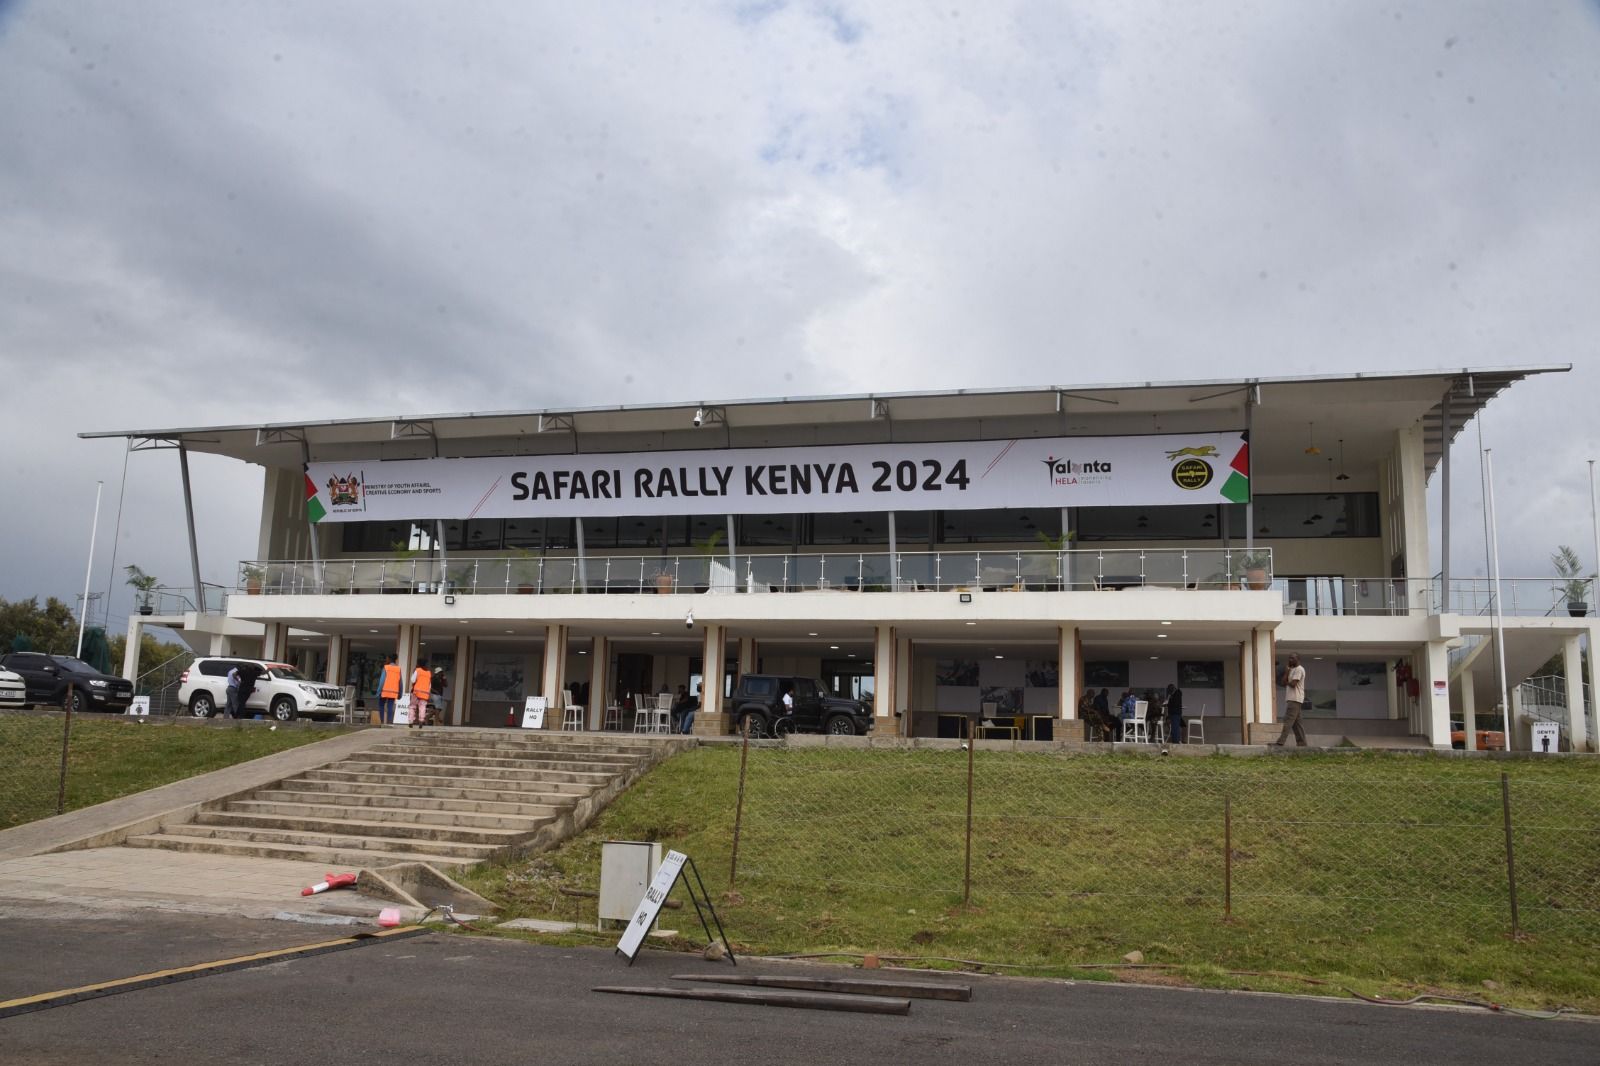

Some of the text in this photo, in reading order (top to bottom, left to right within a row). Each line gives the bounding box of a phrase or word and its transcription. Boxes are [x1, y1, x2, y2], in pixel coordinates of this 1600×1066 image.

[511, 459, 970, 501] SAFARI RALLY KENYA 2024
[1056, 477, 1078, 485] HELA
[646, 886, 665, 904] RALLY
